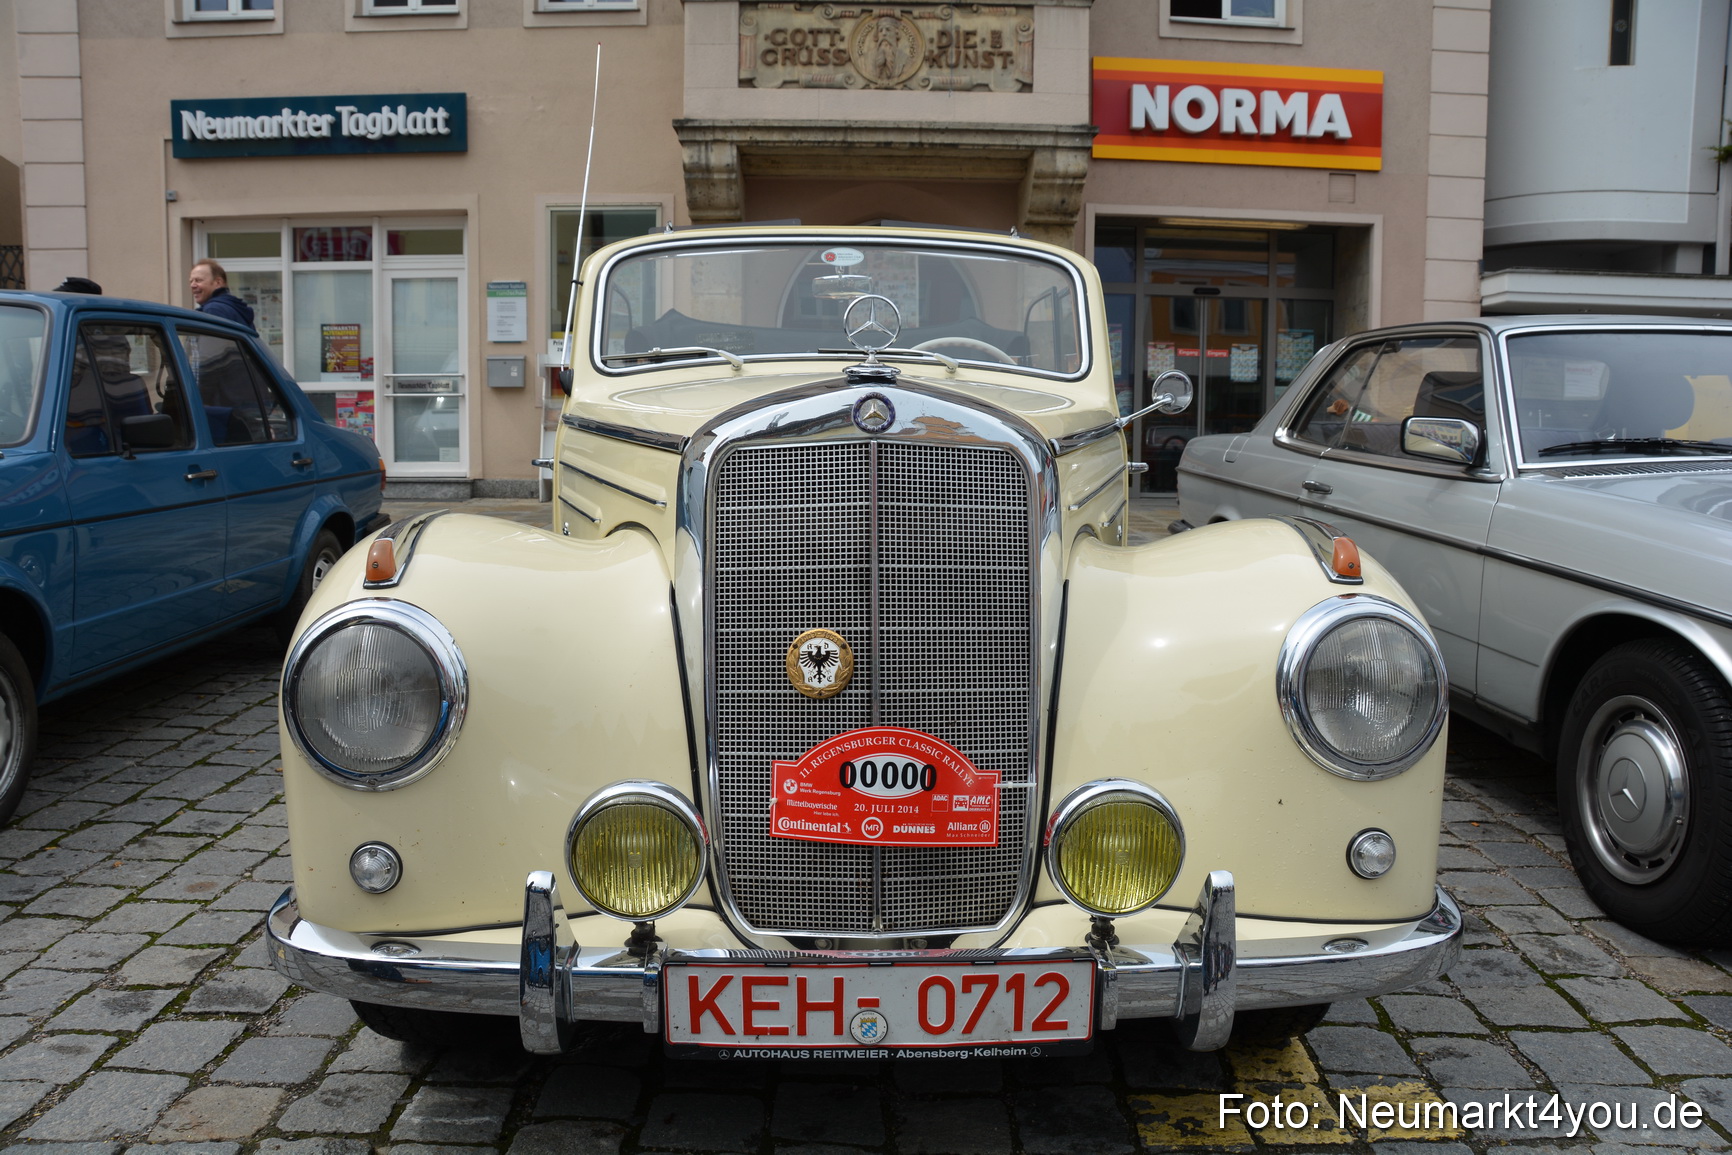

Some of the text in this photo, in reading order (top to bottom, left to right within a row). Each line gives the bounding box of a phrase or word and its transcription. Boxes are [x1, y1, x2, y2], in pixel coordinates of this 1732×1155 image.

[770, 28, 841, 47] GOTT
[937, 30, 977, 49] DIE
[927, 50, 1013, 69] KUNST
[1129, 84, 1352, 139] NORMA
[180, 104, 451, 141] Neumarkter Tagblatt
[799, 736, 974, 787] 11. REGENSBURGER CLASSIC RALLYE
[839, 760, 937, 791] 00000
[786, 799, 838, 810] Mittelbayerische
[854, 803, 919, 814] 20. JULI 2014
[778, 816, 841, 833] Continental
[947, 822, 978, 831] Allianz
[916, 972, 1071, 1035] 0712
[733, 1046, 1027, 1060] AUTOHAUS REITMEIER Abensberg-Kelheim
